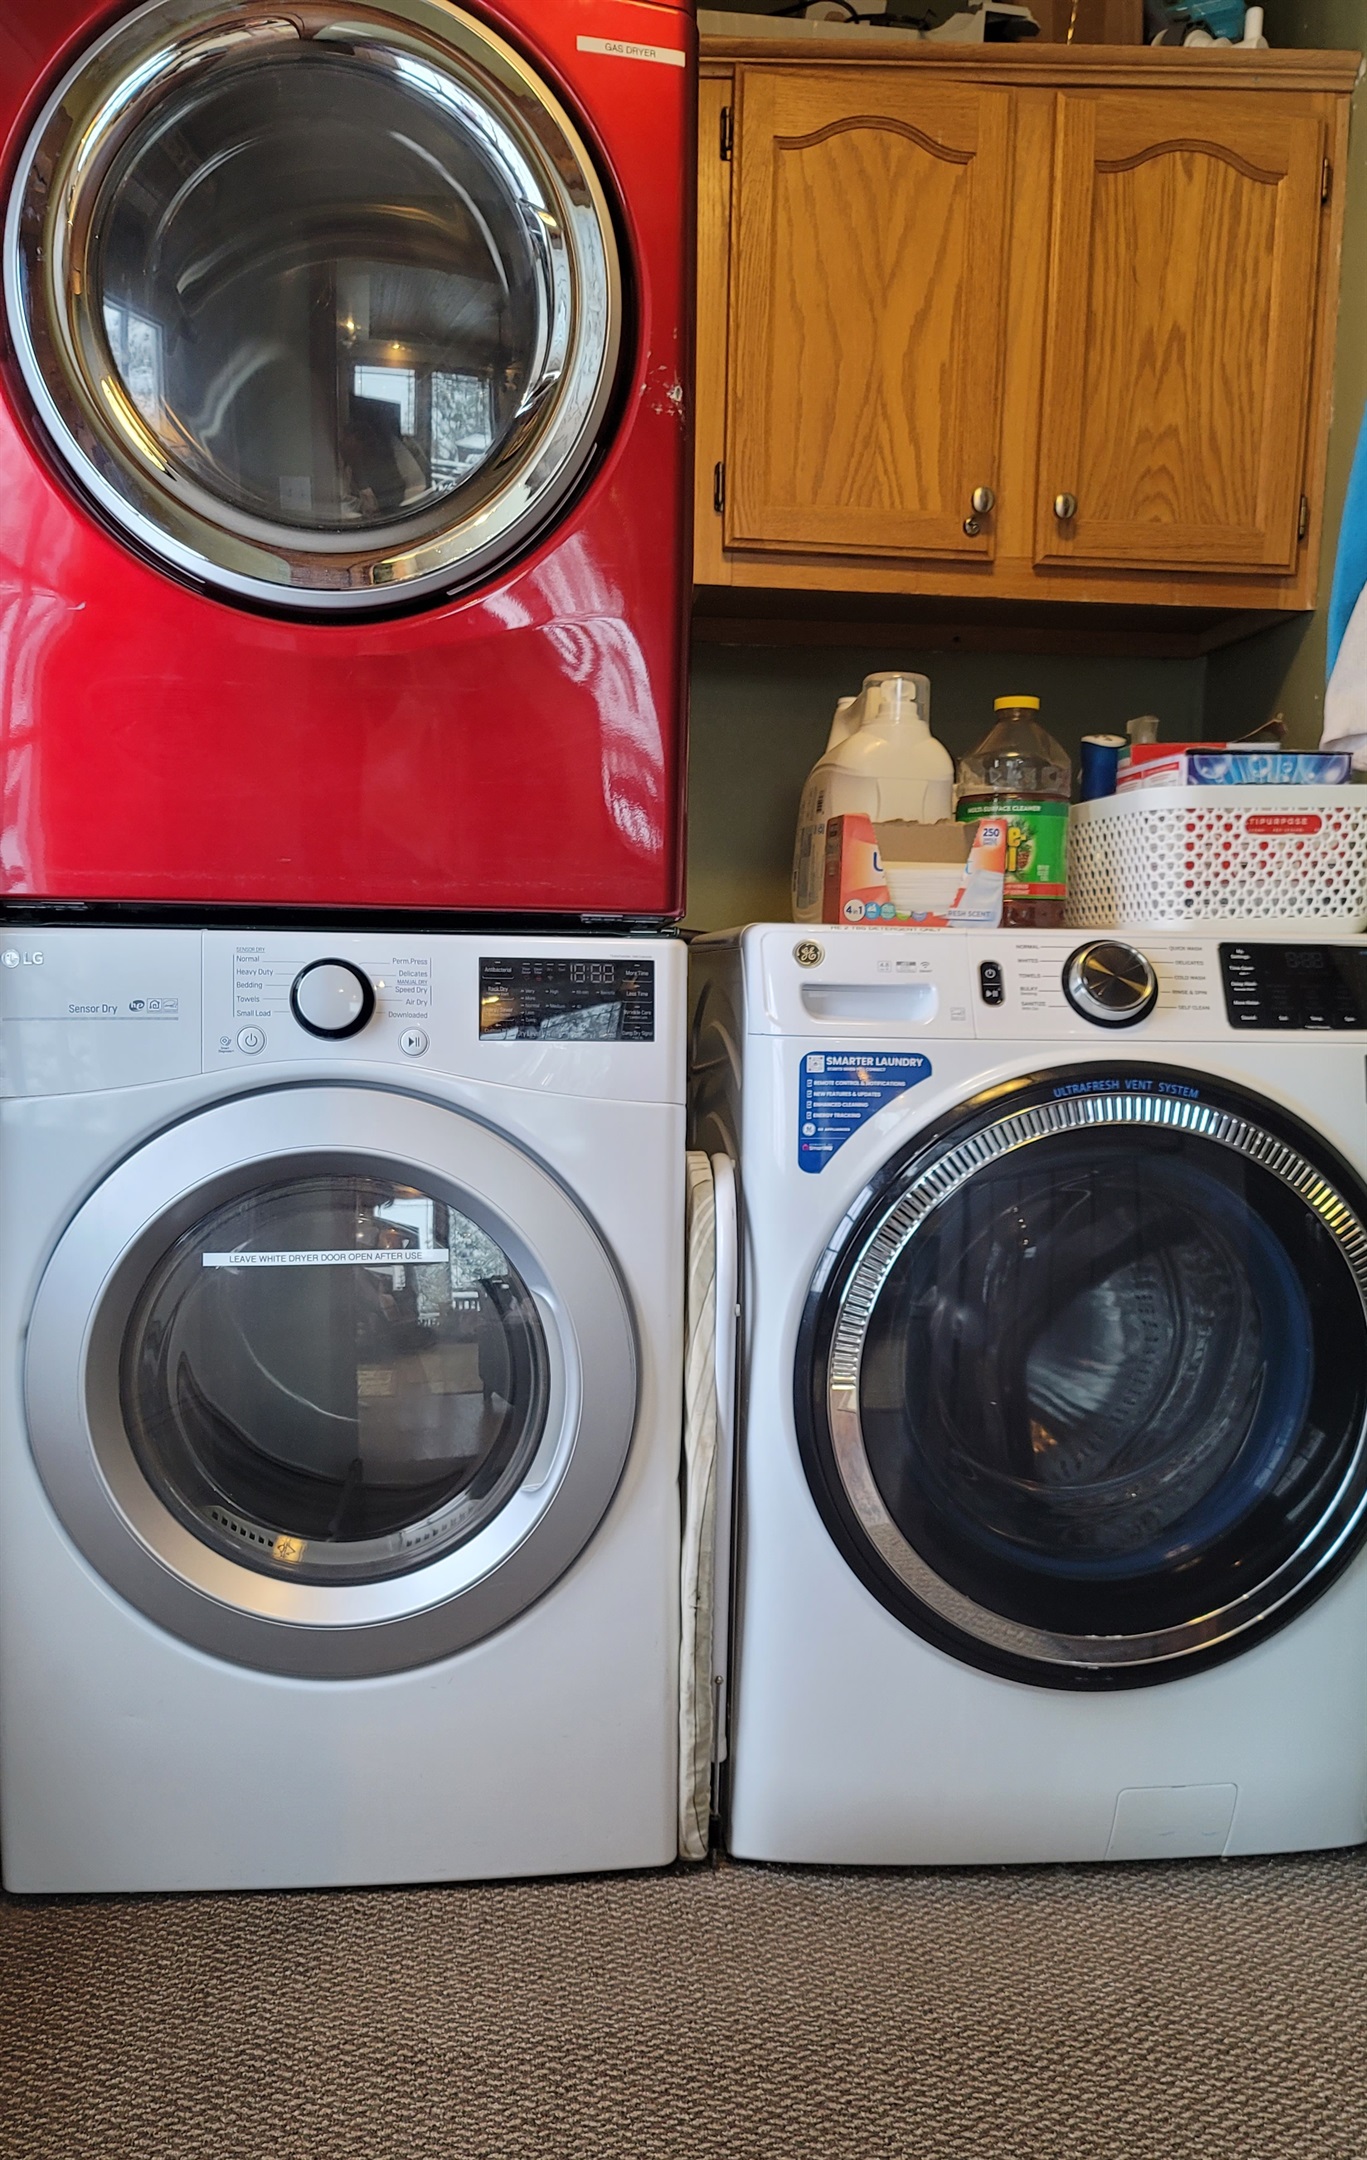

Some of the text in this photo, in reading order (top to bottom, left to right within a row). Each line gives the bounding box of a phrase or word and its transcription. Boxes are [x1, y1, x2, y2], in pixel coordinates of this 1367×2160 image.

[605, 42, 656, 58] GAS DRYER
[983, 828, 1000, 837] 250
[846, 906, 852, 914] 4
[858, 906, 863, 914] 1
[23, 951, 44, 965] LG
[395, 986, 428, 995] Speed Dry
[416, 999, 428, 1007] Dry
[68, 1004, 118, 1015] Sensor Dry
[388, 1011, 428, 1019] Downloaded
[826, 1056, 924, 1067] SMARTER LAUNDRY
[1053, 1080, 1200, 1099] ULTRAFRESH VENT SYSTEM
[229, 1255, 257, 1263] LEAVE
[288, 1254, 319, 1262] DRYER
[321, 1253, 346, 1261] DOOR
[348, 1253, 373, 1261] OPEN
[374, 1252, 403, 1260] AFTER
[405, 1252, 423, 1260] USE
